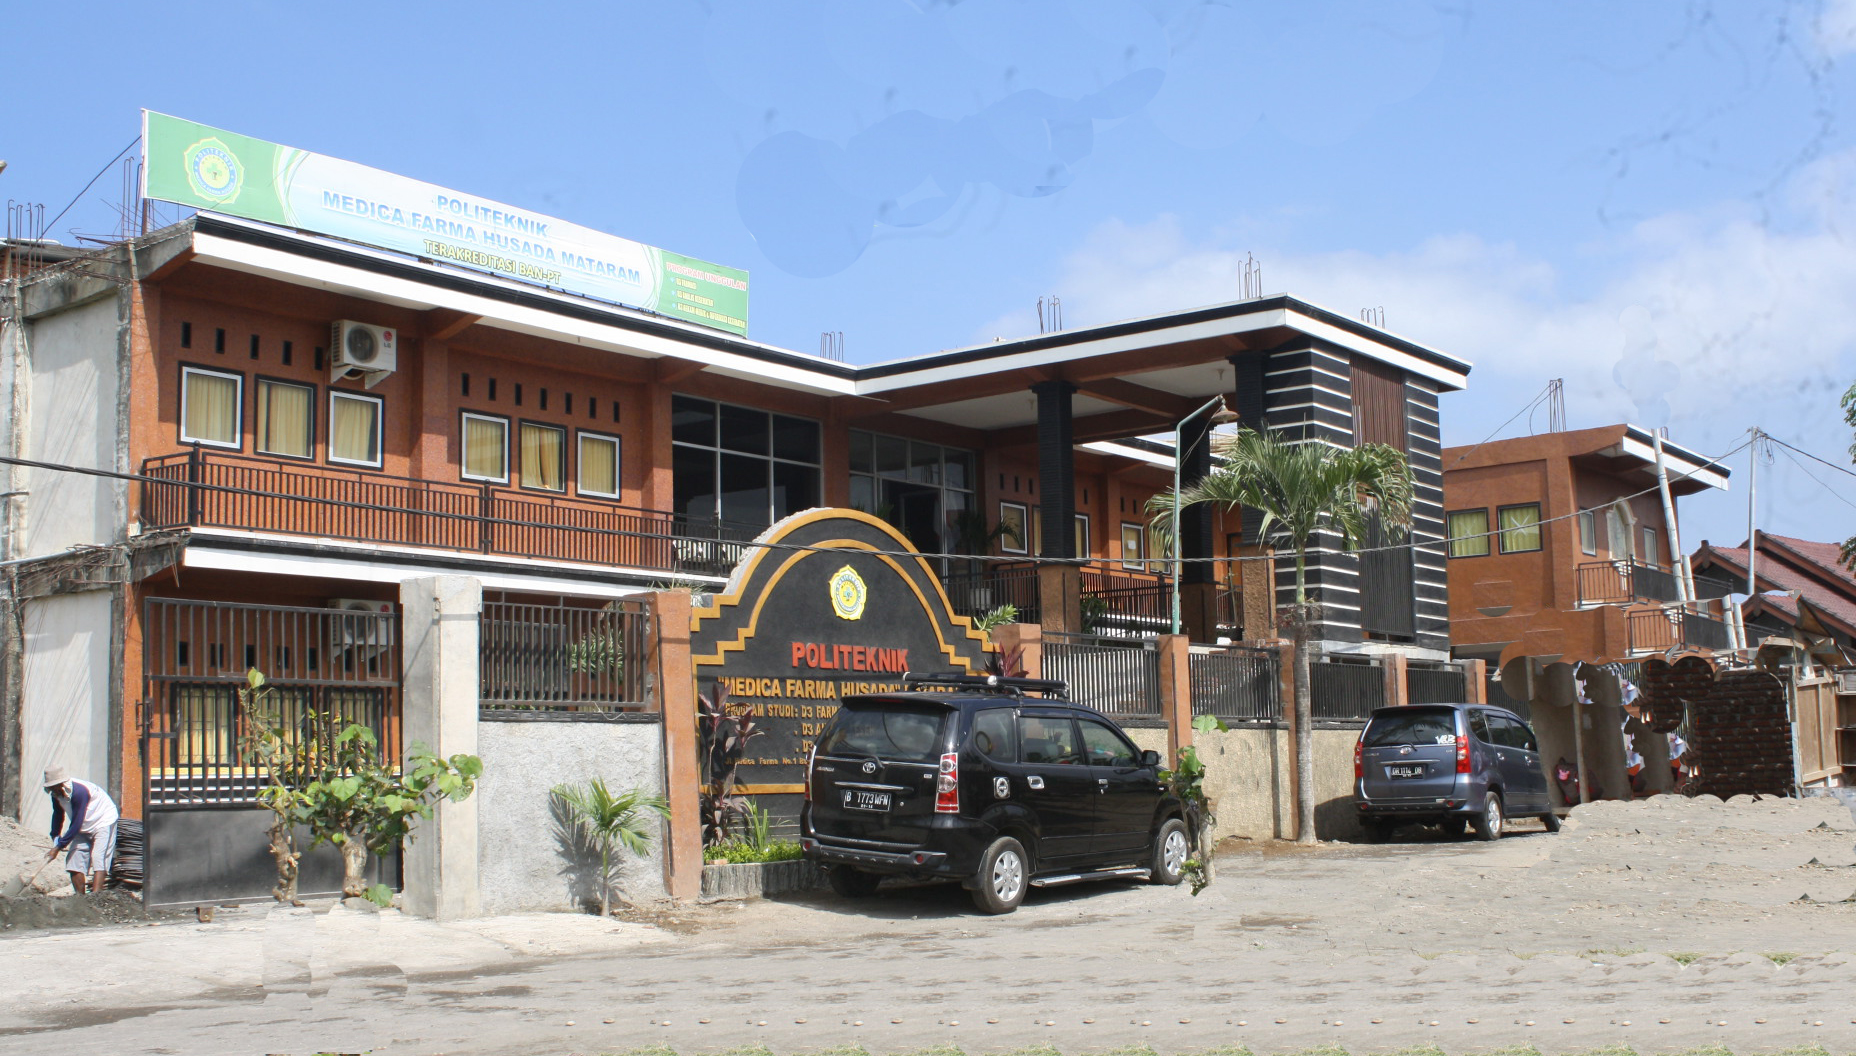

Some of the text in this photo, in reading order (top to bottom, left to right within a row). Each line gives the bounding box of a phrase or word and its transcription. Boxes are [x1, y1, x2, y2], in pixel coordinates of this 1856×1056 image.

[437, 194, 548, 237] POLITEKNIK
[323, 190, 640, 283] MEDICA FARMA HUSADA MATARAM
[424, 239, 561, 284] TERAKREDITASI BAN-PT
[665, 262, 704, 280] PROGRAM
[705, 272, 747, 291] UNGGULAN
[792, 641, 909, 672] POLITEKNIK
[786, 679, 837, 699] FARMA
[767, 703, 798, 718] STUDI:
[801, 705, 813, 719] D3
[802, 723, 813, 736] D3
[759, 757, 779, 765] Farma
[846, 791, 852, 802] B
